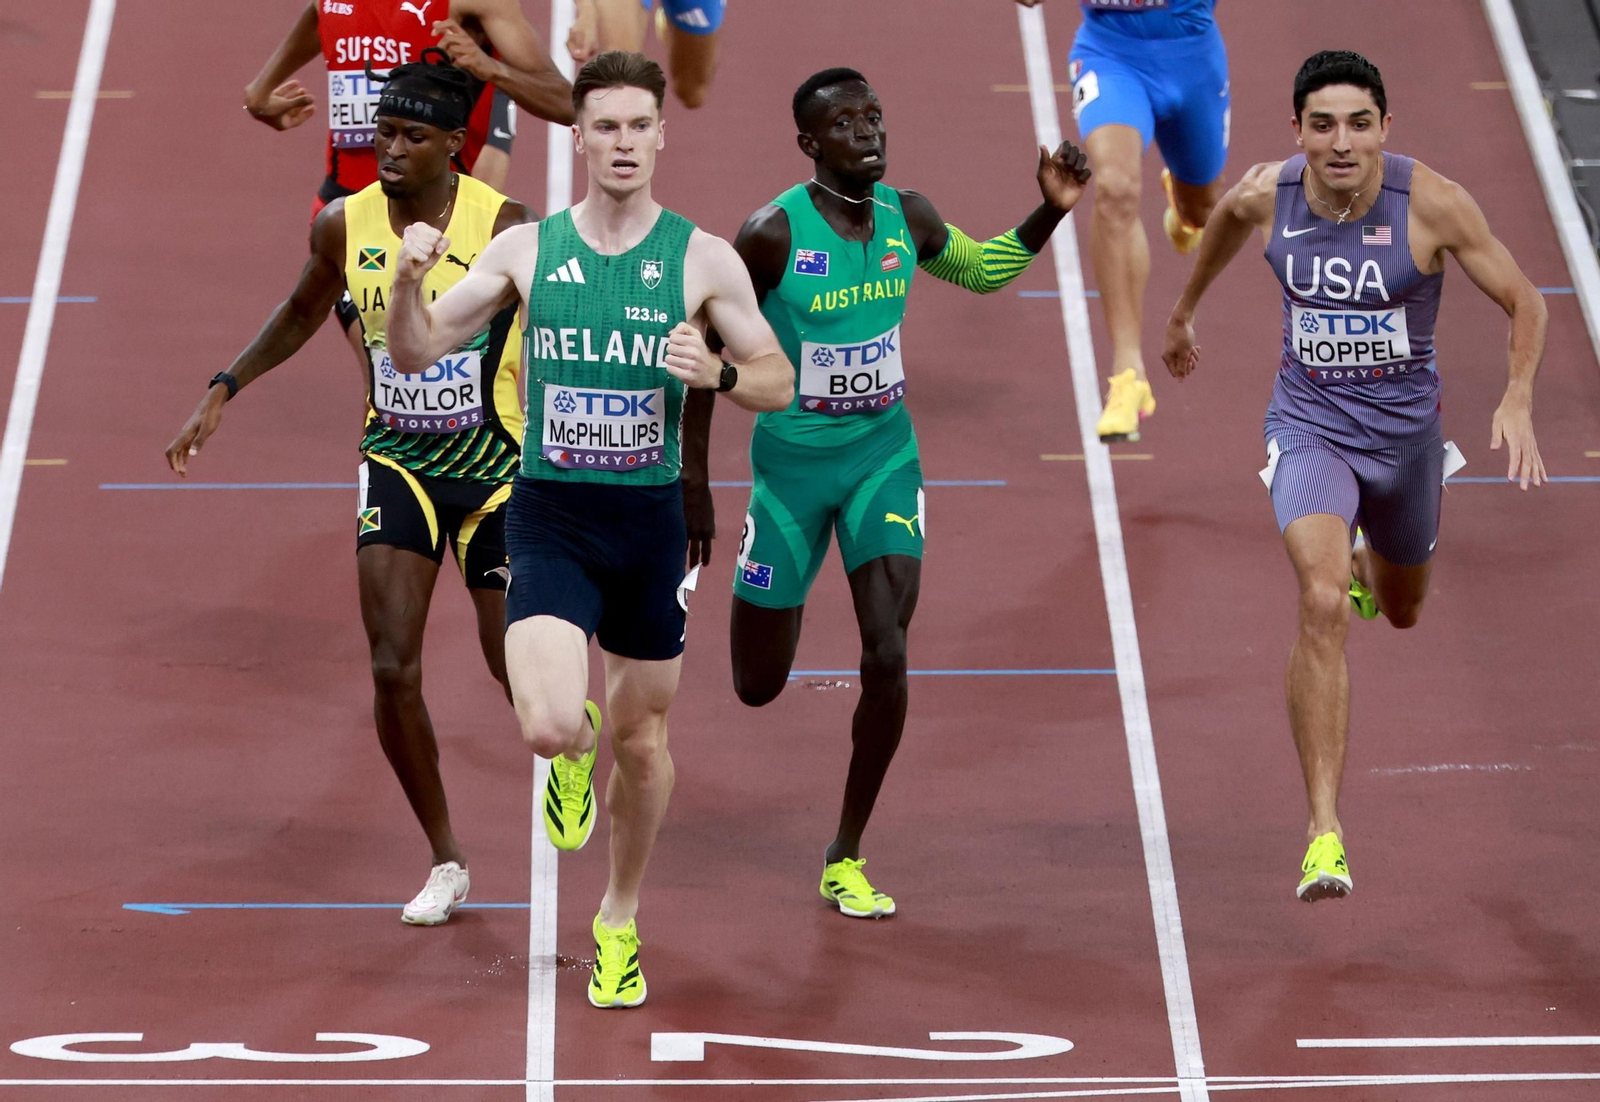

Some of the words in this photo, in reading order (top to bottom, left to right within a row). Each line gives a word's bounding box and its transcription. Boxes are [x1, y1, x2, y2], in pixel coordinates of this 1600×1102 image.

[332, 102, 379, 125] PELIZ
[1286, 254, 1390, 302] USA
[809, 279, 906, 313] AUSTRALIA
[624, 306, 668, 323] 123.ie
[1318, 312, 1397, 335] TDK
[533, 325, 669, 368] IRELAND
[835, 331, 896, 367] TDK
[1299, 338, 1404, 362] HOPPEL
[829, 369, 888, 395] BOL
[380, 383, 475, 411] TAYLOR
[576, 392, 656, 417] TDK
[549, 419, 659, 448] McPHILLIPS
[9, 1033, 431, 1062] 3
[651, 1032, 1075, 1061] 2
